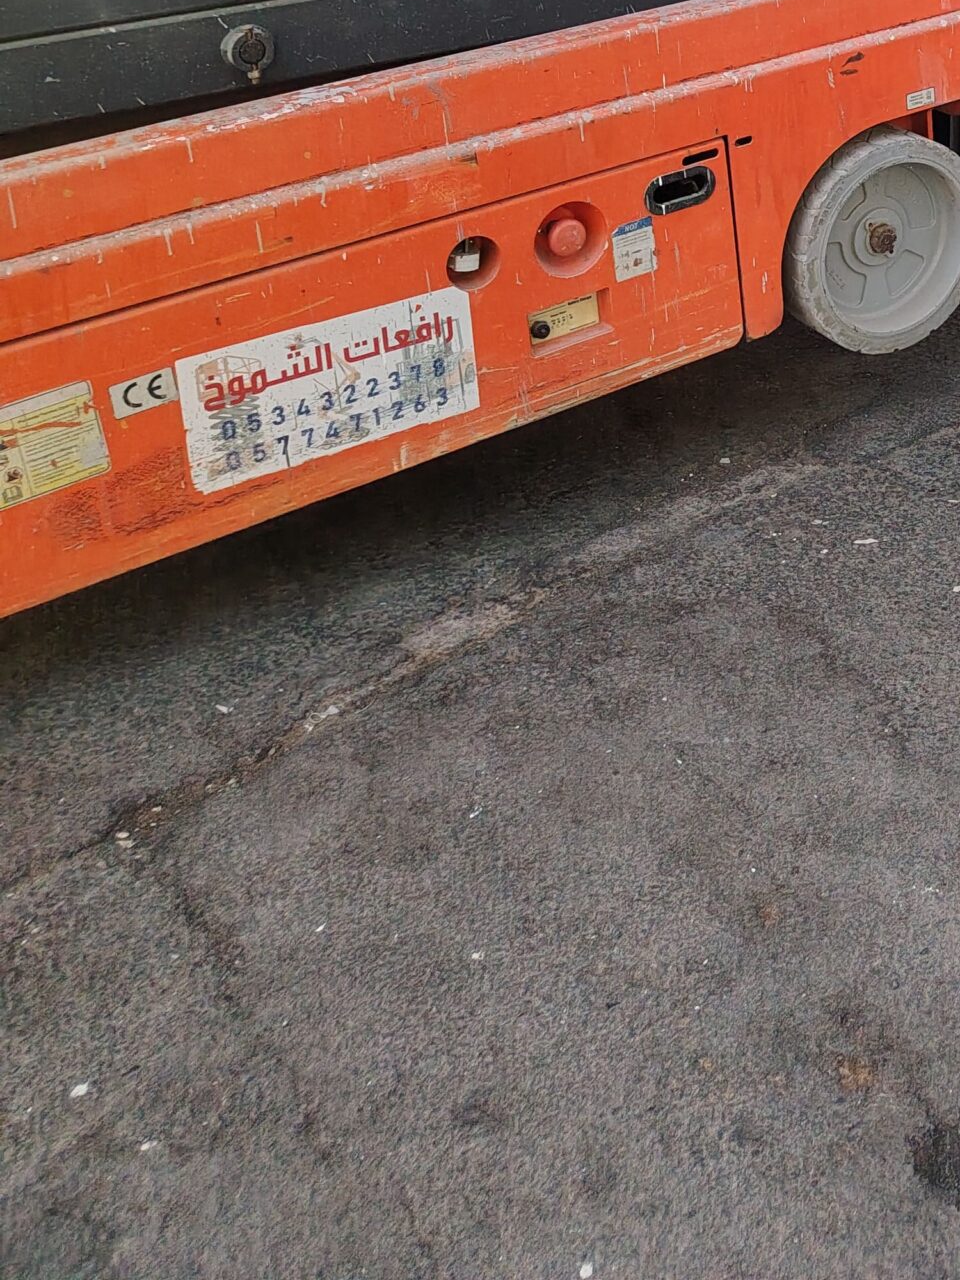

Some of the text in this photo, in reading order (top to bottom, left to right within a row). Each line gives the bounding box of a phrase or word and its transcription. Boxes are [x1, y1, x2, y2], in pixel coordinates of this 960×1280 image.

[203, 305, 454, 412] رافعات الشموخ
[220, 356, 447, 440] 0534322378
